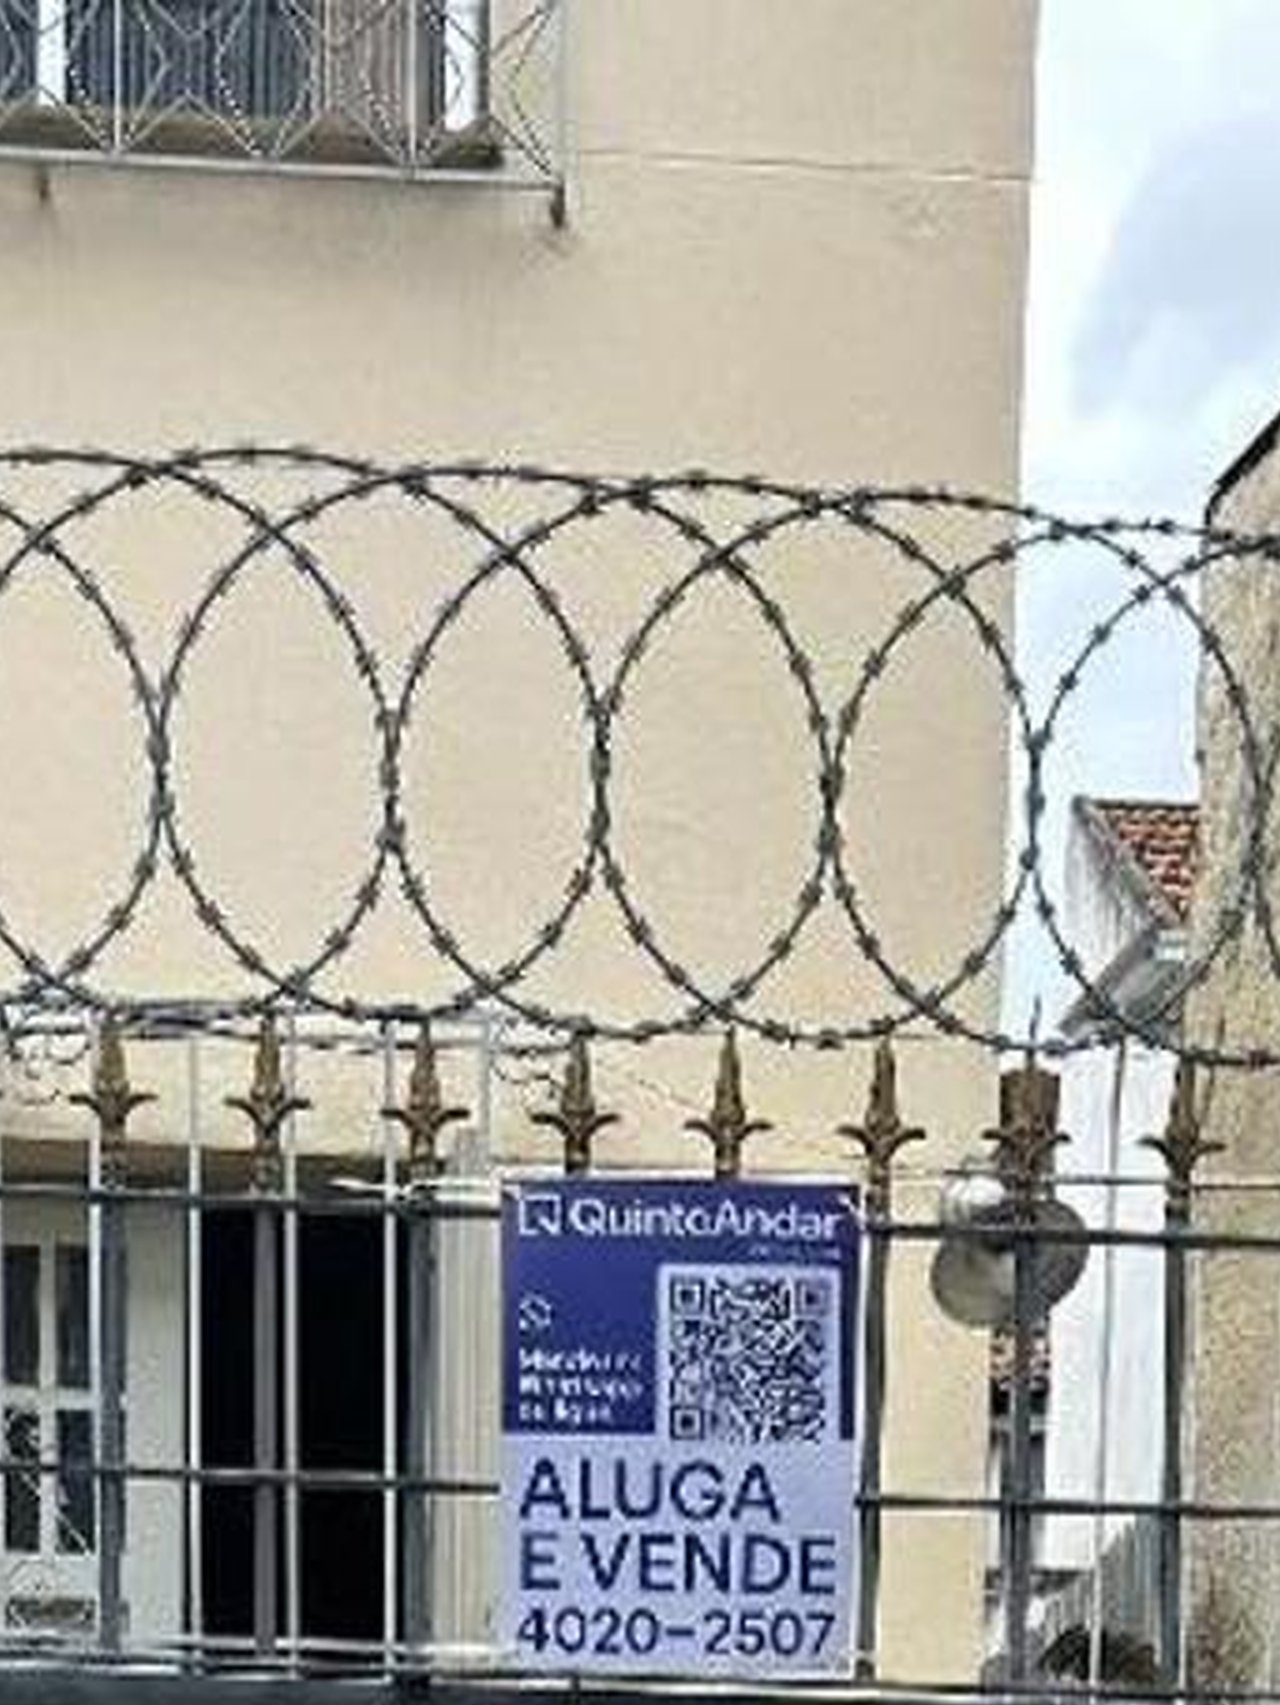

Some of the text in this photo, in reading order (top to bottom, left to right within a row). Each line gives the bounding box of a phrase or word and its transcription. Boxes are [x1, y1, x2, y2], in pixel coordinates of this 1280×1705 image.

[570, 1198, 841, 1240] QuintoAndar
[519, 1457, 782, 1523] ALUGA
[521, 1530, 837, 1597] E VENDE
[517, 1607, 836, 1656] 4020-2507
